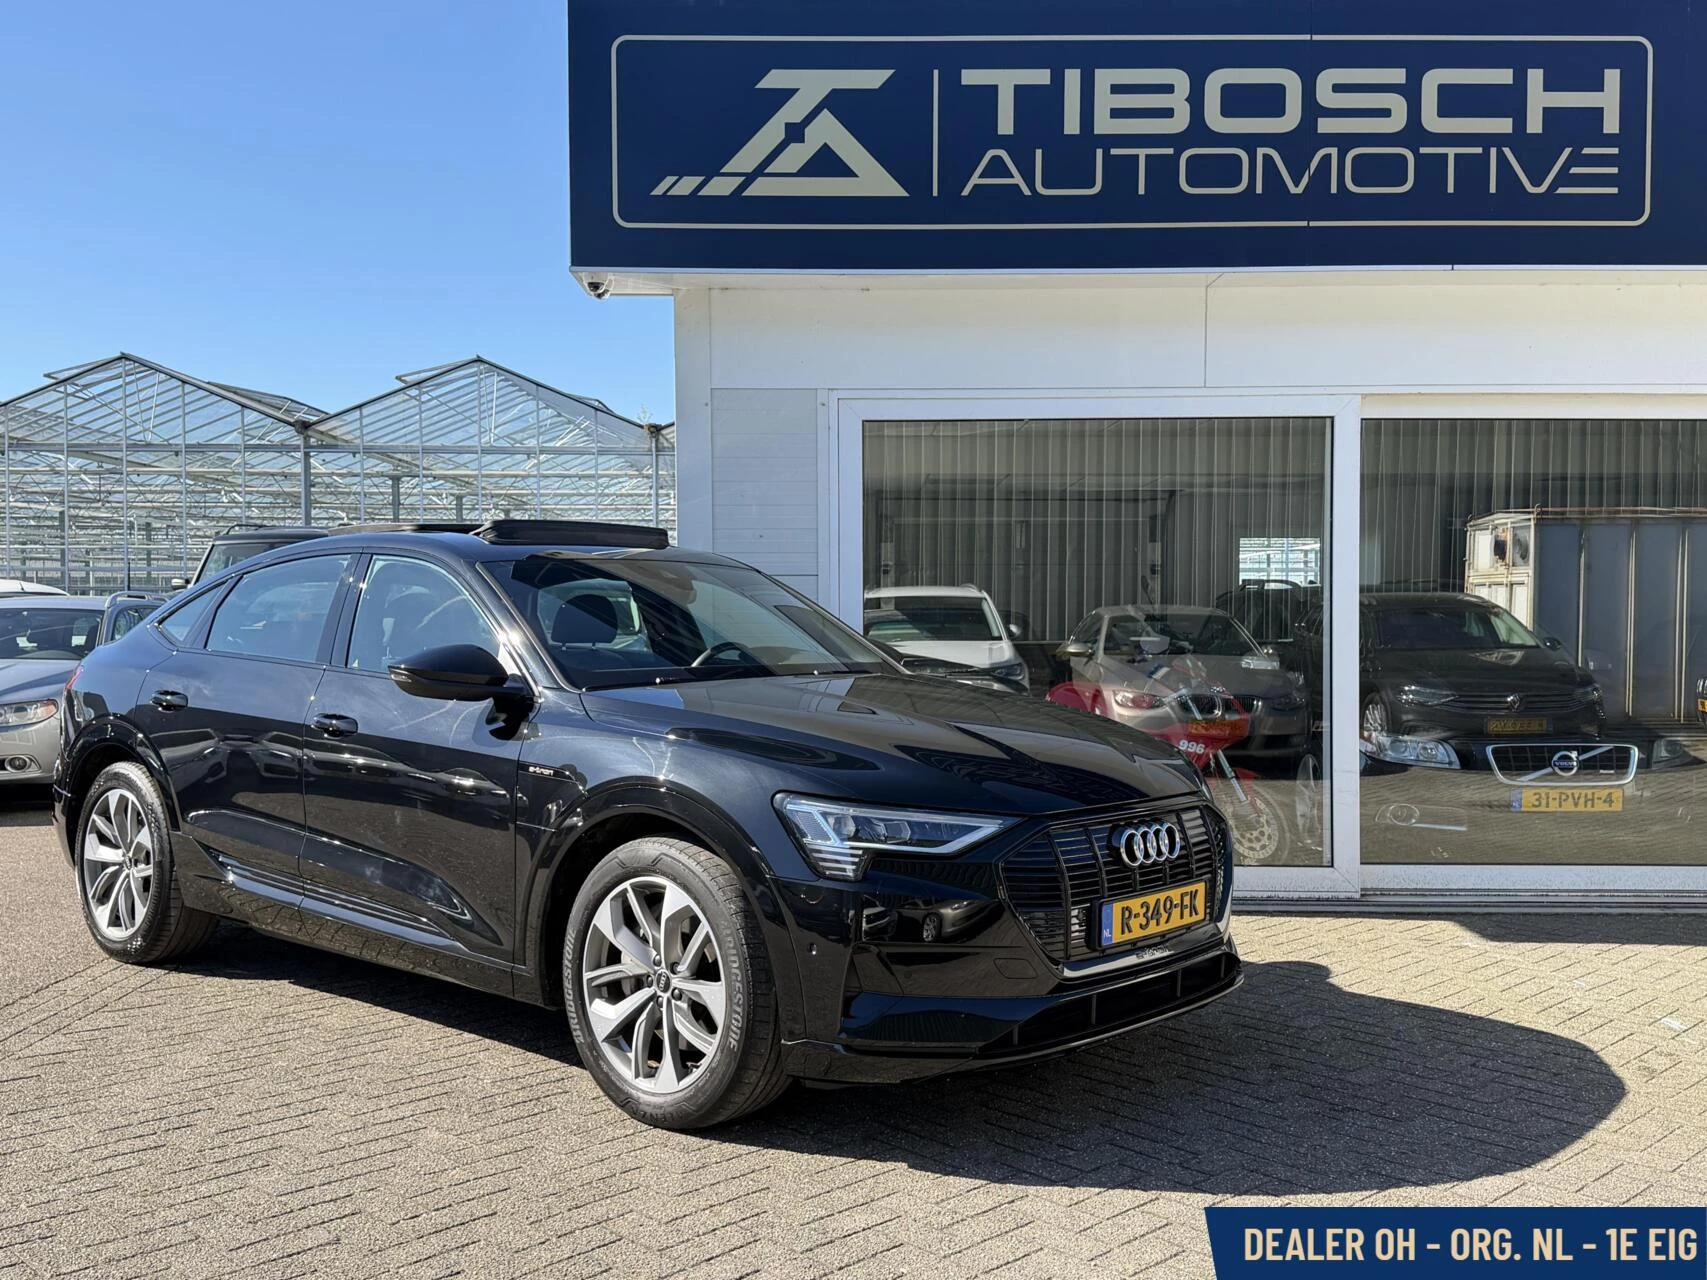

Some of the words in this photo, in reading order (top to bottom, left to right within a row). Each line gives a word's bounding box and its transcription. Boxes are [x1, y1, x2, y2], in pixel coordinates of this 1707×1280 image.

[960, 68, 1621, 135] TIBOSCH
[960, 147, 1619, 196] AUTOMOTIVE
[1178, 739, 1205, 754] 996
[1531, 792, 1615, 809] 31-PVH-4
[1104, 929, 1112, 938] NL
[1120, 889, 1199, 936] R-349-FK
[563, 928, 585, 1043] BRIDGESTONE
